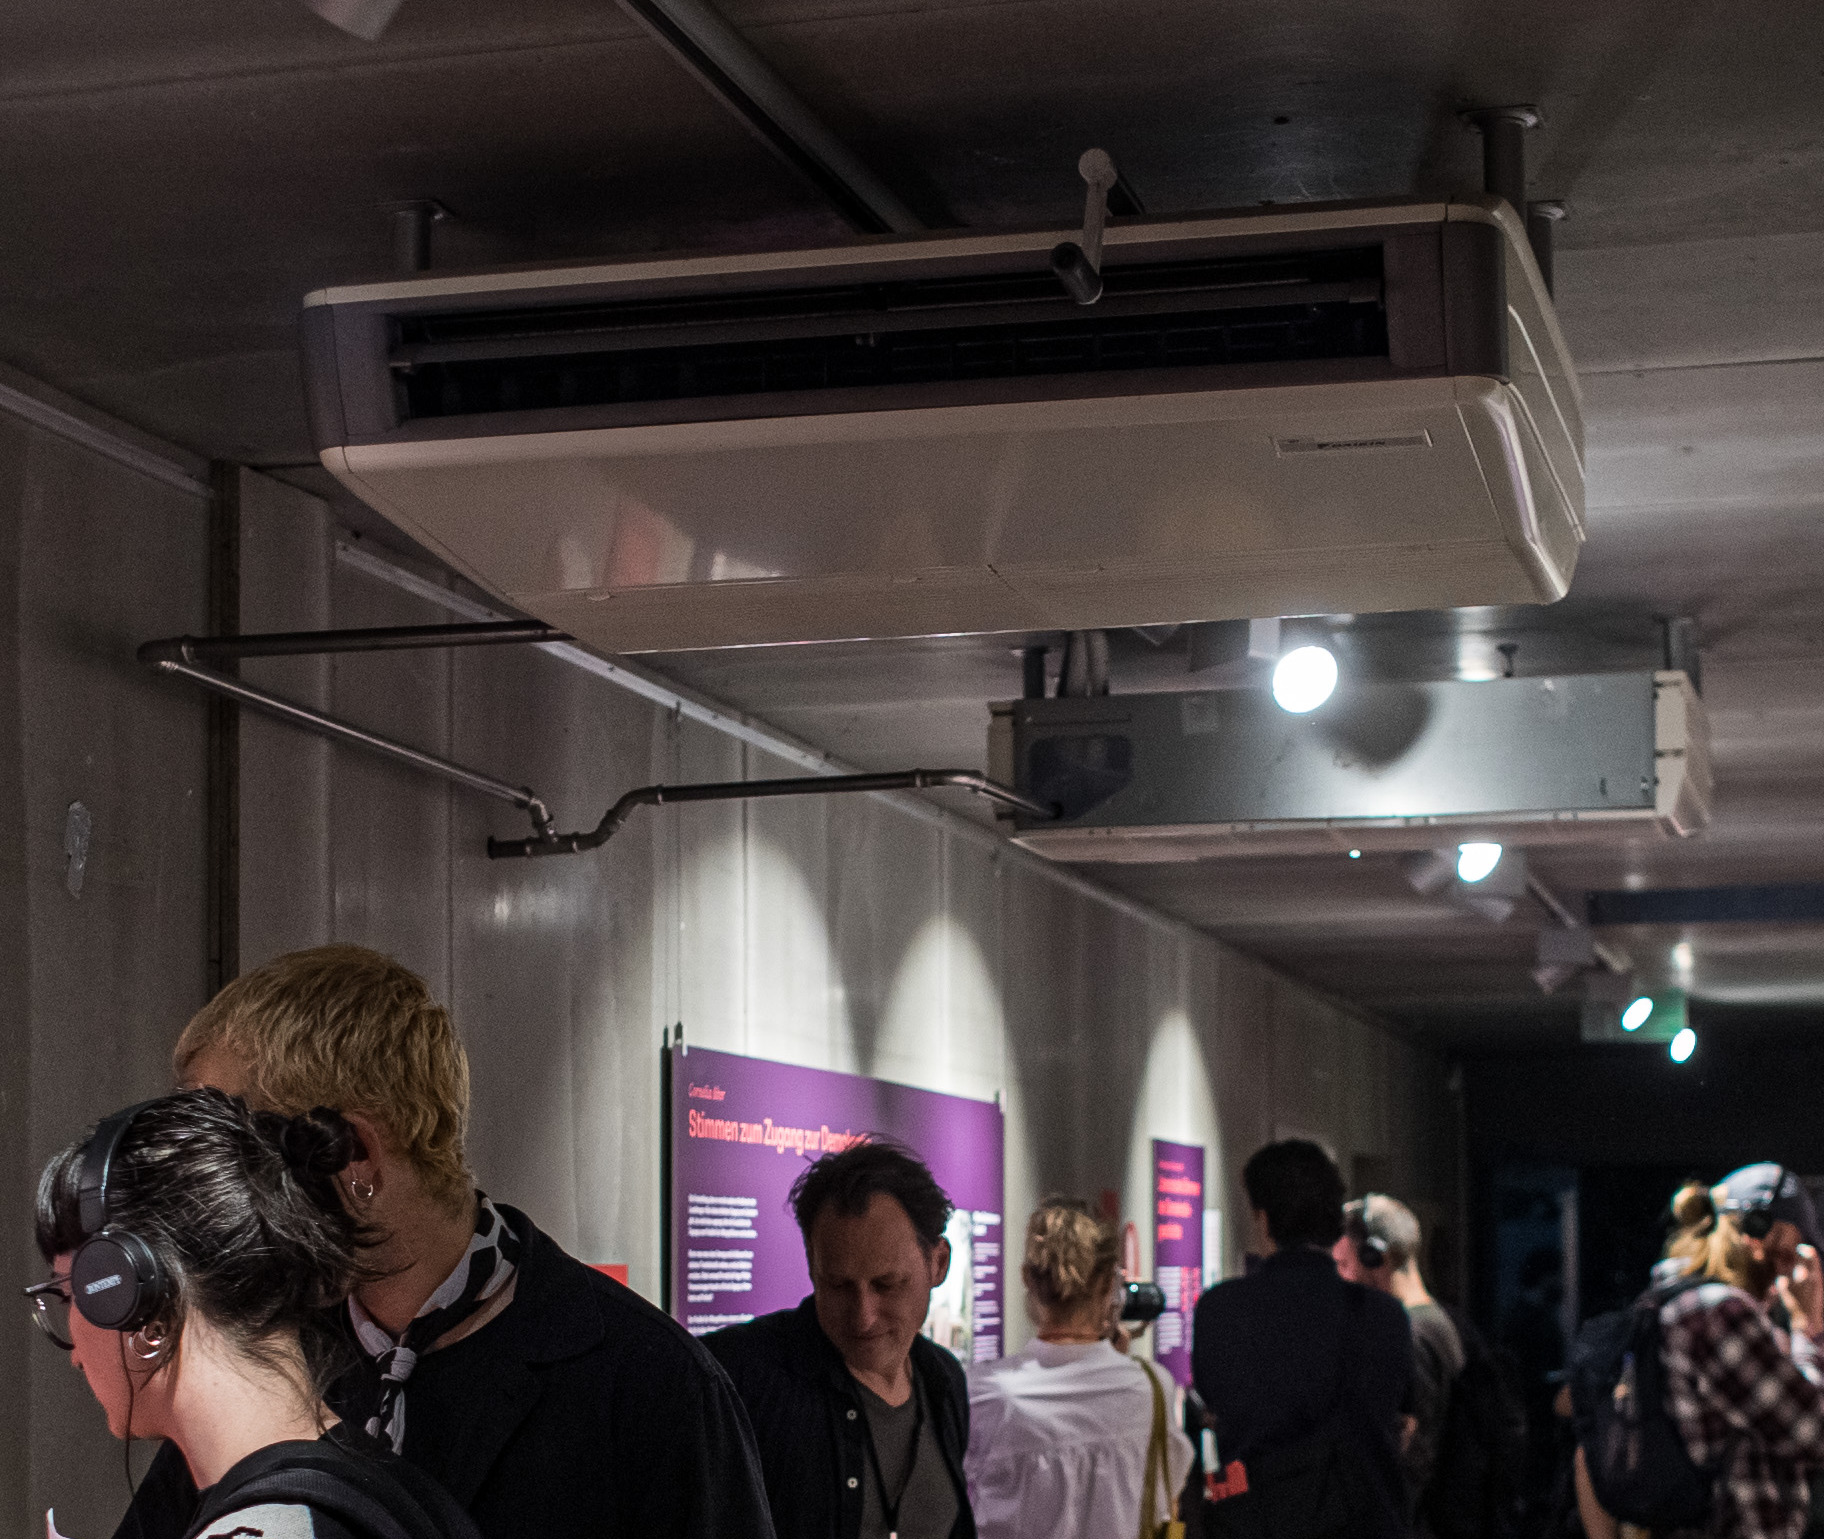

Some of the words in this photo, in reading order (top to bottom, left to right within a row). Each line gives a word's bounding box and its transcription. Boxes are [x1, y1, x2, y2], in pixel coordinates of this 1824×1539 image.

[688, 1108, 738, 1142] Stimmen
[739, 1121, 763, 1145] zum
[763, 1118, 804, 1156] Zugang
[804, 1128, 821, 1151] zur
